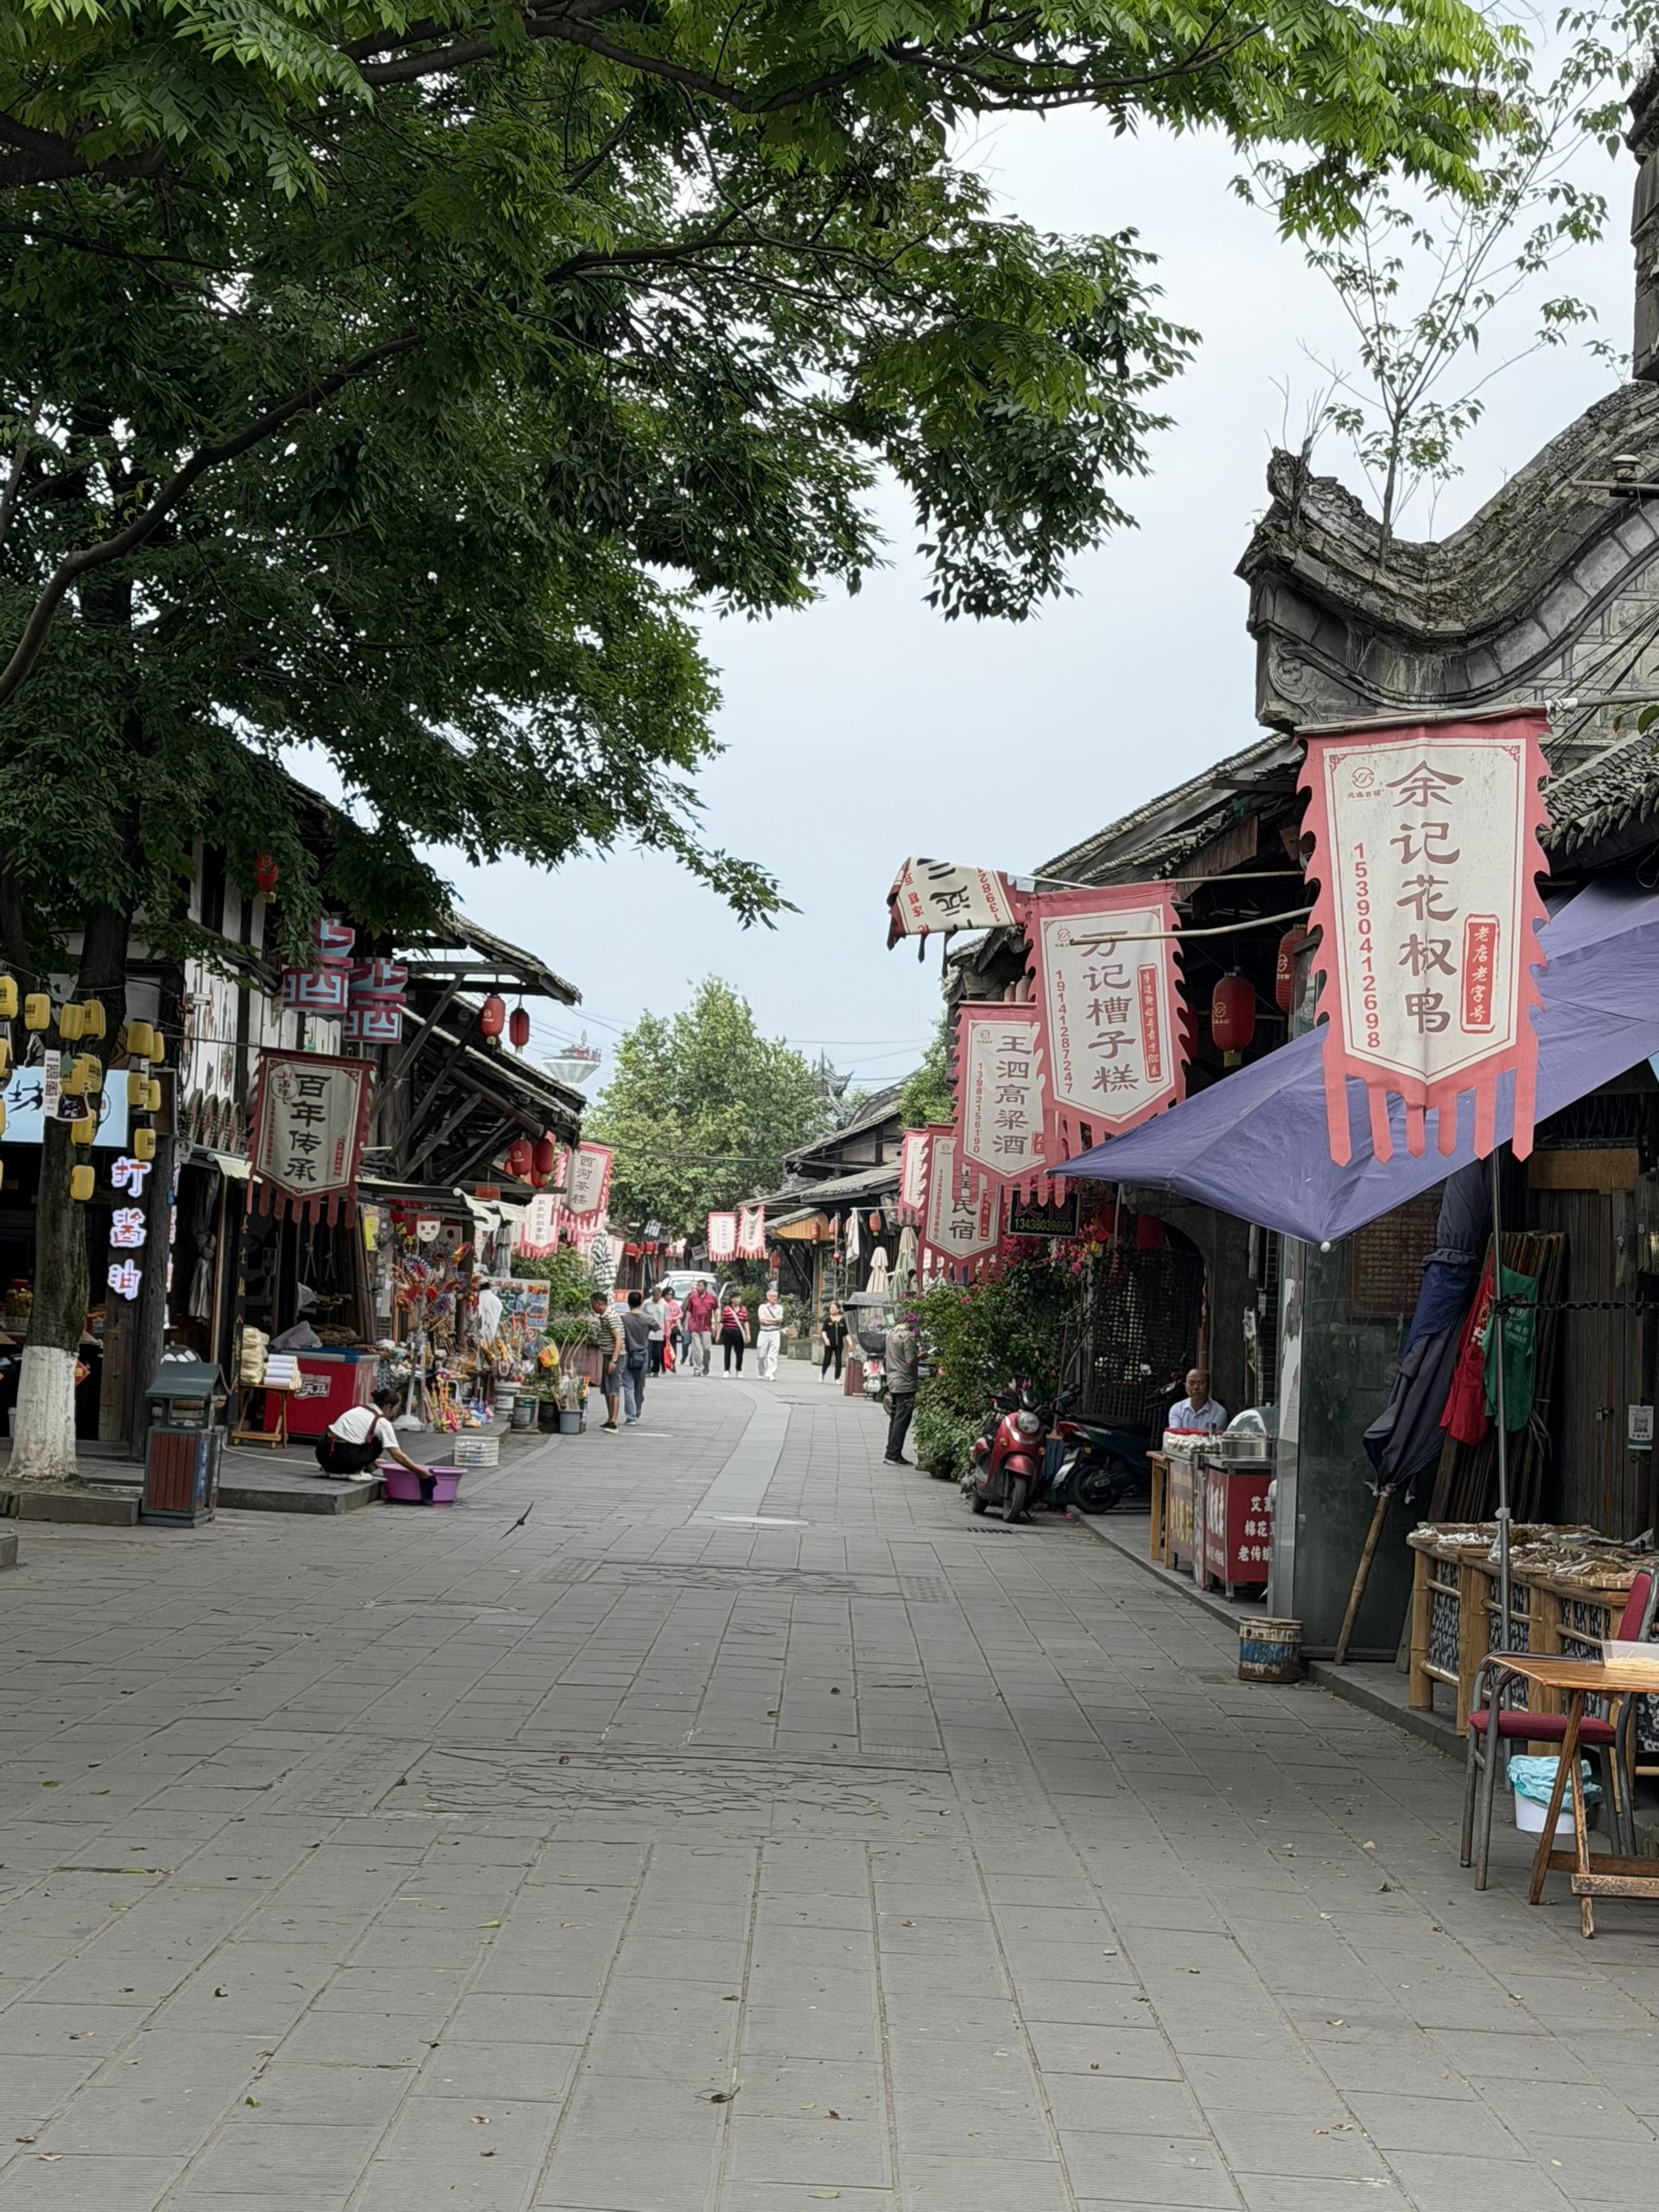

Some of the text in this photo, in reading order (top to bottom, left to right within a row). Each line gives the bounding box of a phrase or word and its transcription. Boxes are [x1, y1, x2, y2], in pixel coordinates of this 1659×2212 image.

[1354, 842, 1381, 1048] 15390412698
[1469, 925, 1490, 1023] 老店老字号
[1055, 969, 1073, 1094] 19141287247
[1080, 931, 1140, 1094] 万记槽子糕
[283, 1073, 332, 1182] 百年传承
[973, 1062, 983, 1154] 13982156190
[108, 1156, 152, 1300] 打酱油
[571, 1155, 596, 1205] 西河茶楼
